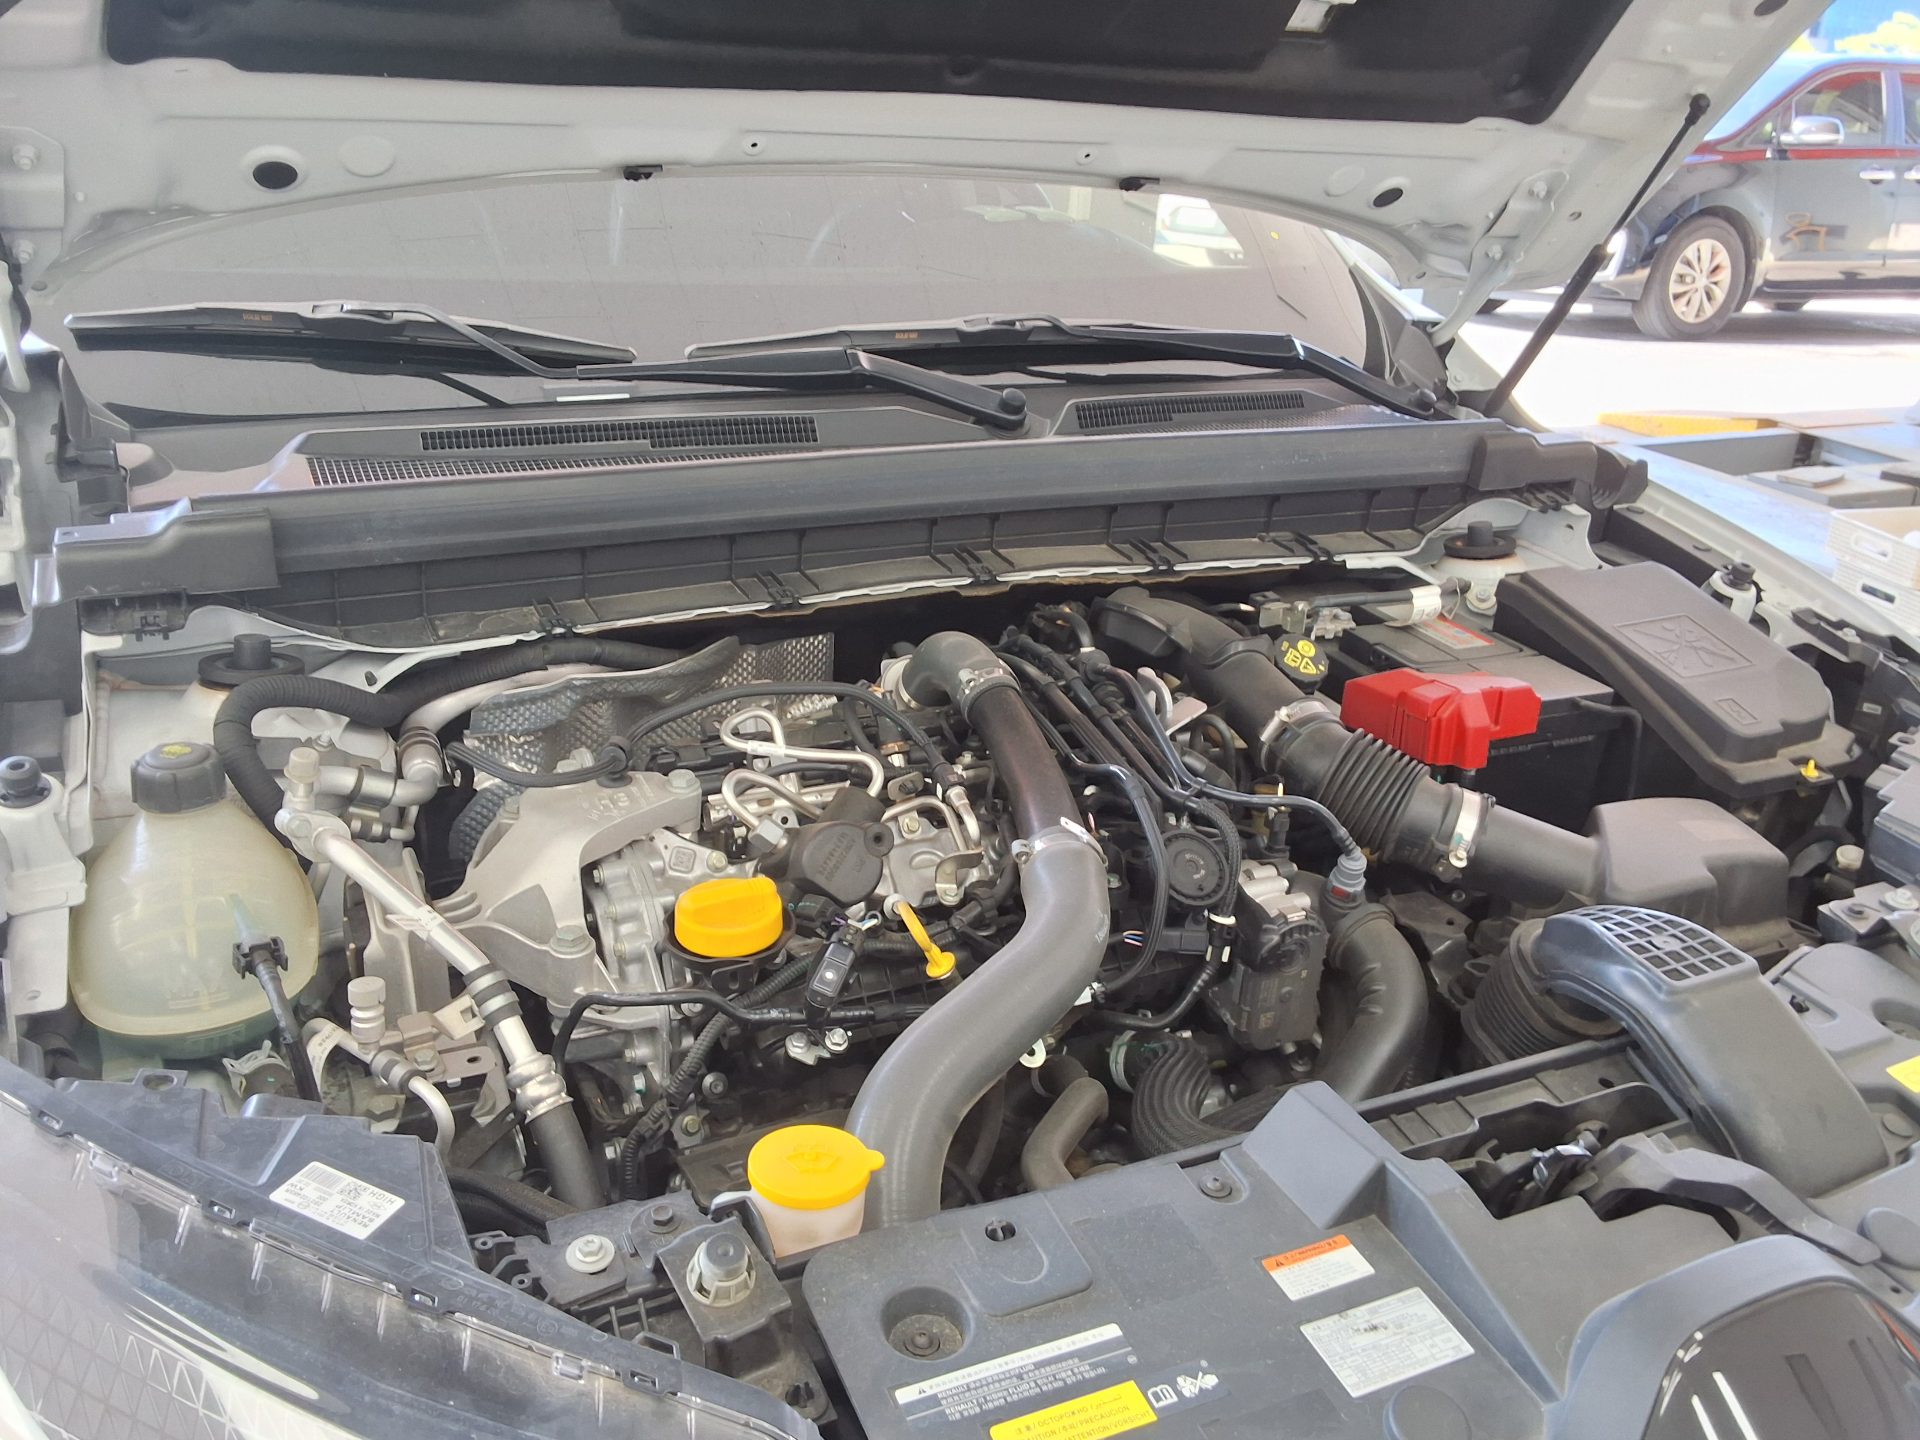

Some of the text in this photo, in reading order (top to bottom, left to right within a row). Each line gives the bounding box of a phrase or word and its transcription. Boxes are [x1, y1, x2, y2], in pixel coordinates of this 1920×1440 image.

[367, 1189, 397, 1205] HIGH
[330, 1208, 369, 1228] RENAULT
[937, 1383, 968, 1398] RENAULT
